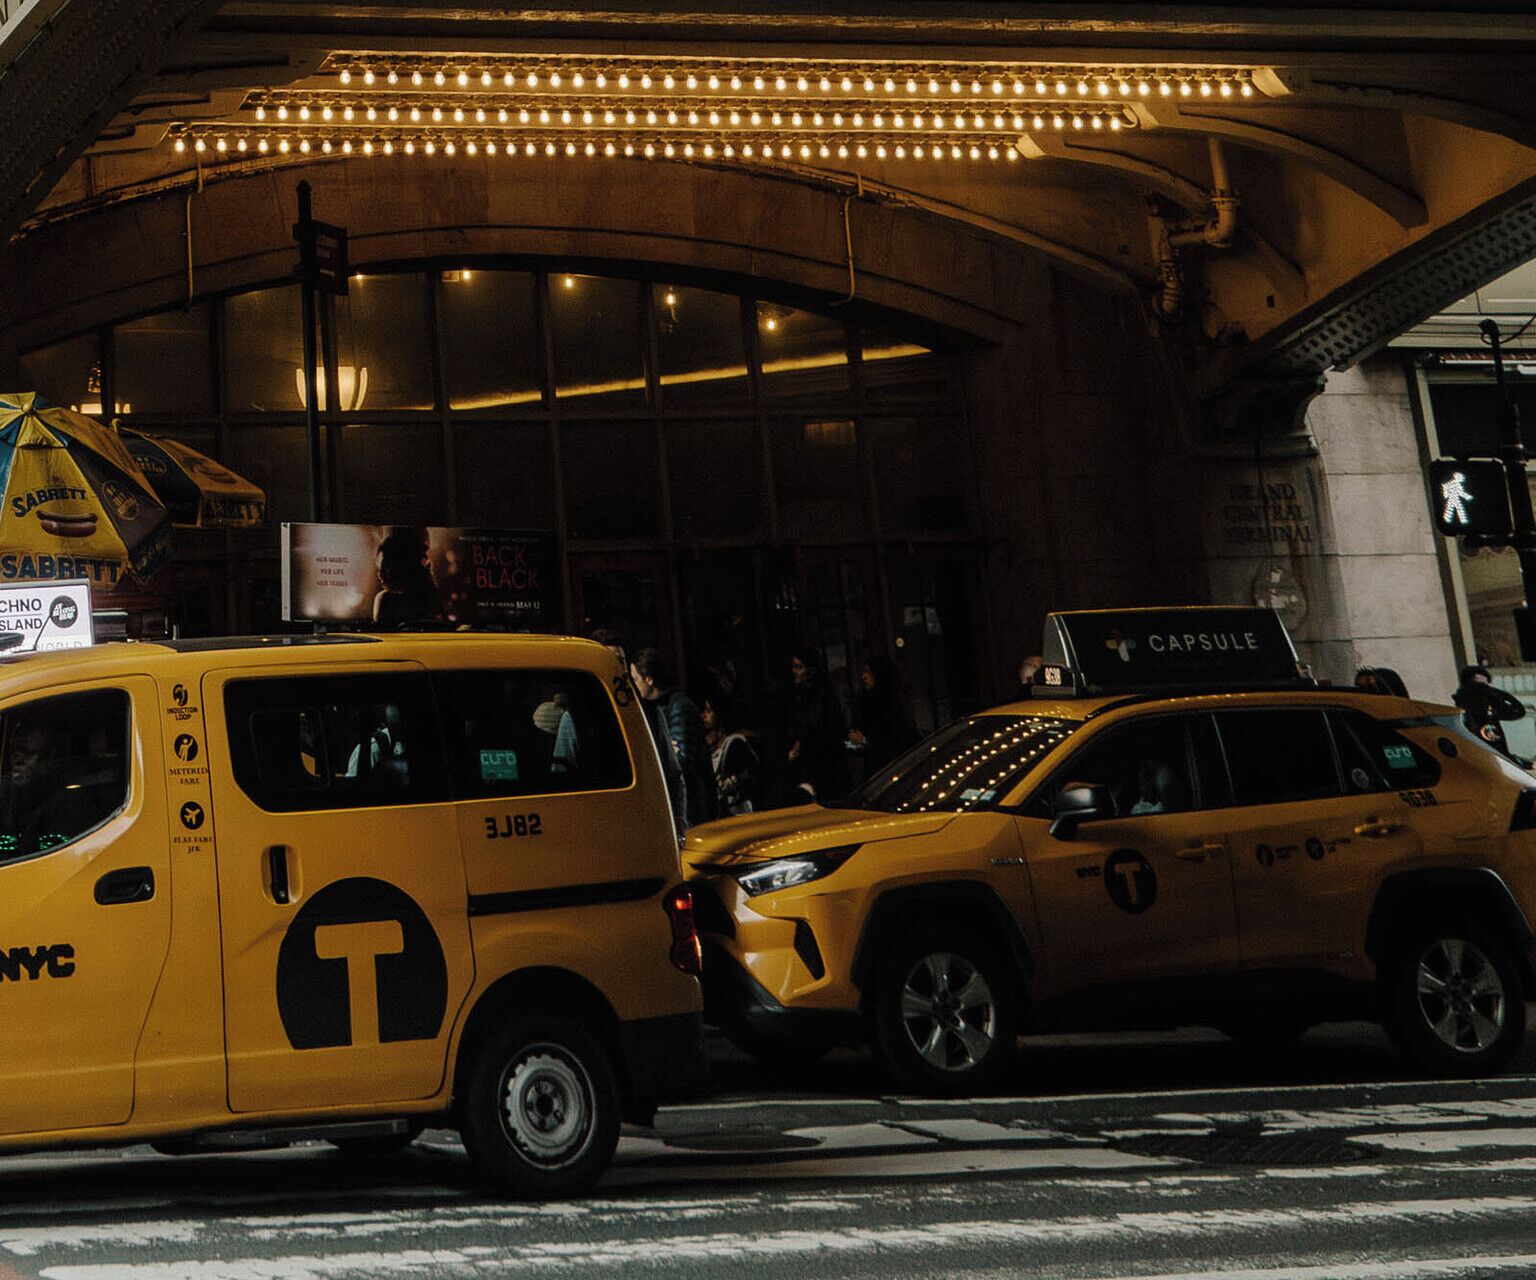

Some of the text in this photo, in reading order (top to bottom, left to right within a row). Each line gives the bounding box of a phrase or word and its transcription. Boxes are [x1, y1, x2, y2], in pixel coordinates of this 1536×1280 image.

[11, 487, 88, 519] SABRETT
[0, 553, 124, 583] SABRETT
[470, 544, 529, 567] BACK
[474, 567, 539, 590] BLACK
[1148, 631, 1260, 653] CAPSULE
[484, 812, 543, 840] 3J82
[313, 919, 405, 1046] T
